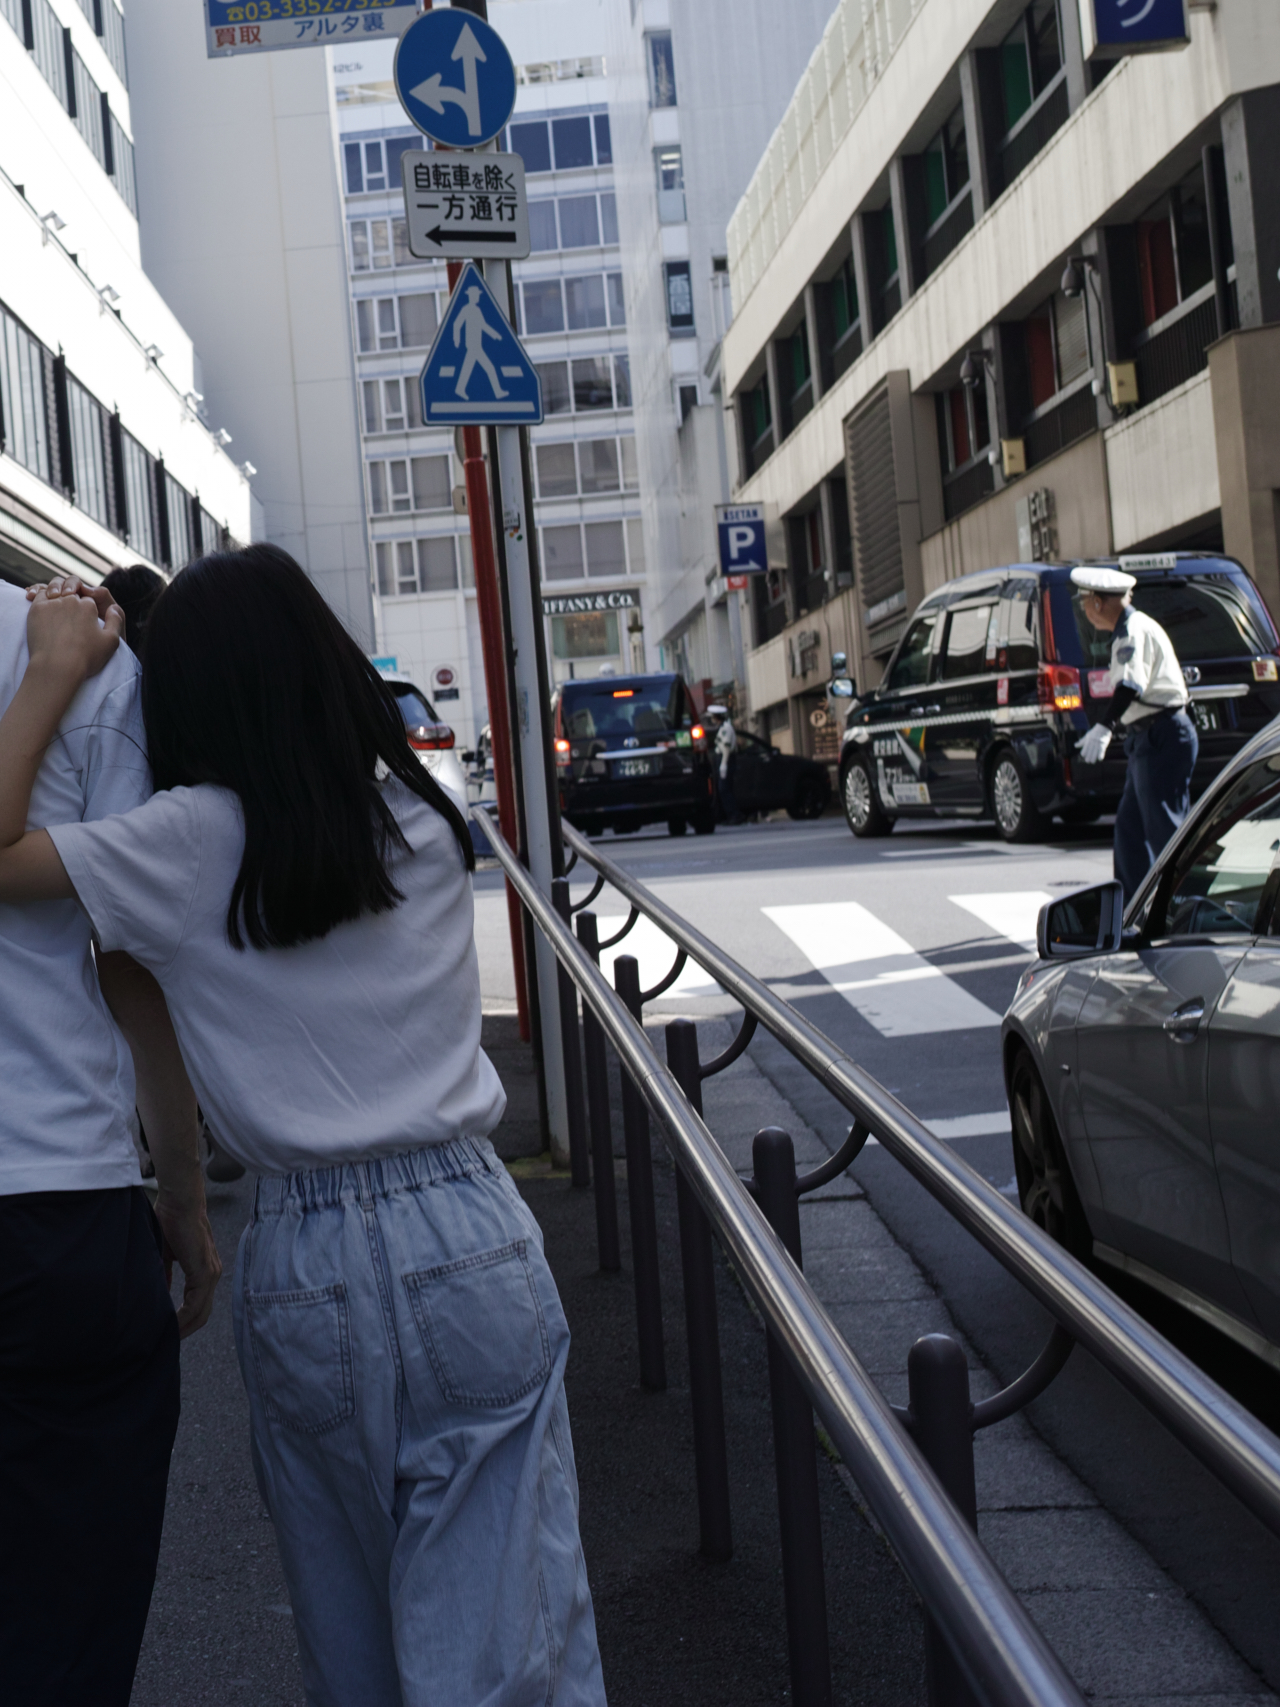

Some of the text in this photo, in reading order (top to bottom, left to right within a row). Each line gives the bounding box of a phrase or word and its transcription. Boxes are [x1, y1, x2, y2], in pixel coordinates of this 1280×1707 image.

[214, 12, 385, 48] 買取 アルタ裏
[414, 162, 516, 191] 自転車を除く
[417, 193, 518, 222] 一方通行
[728, 525, 756, 560] P
